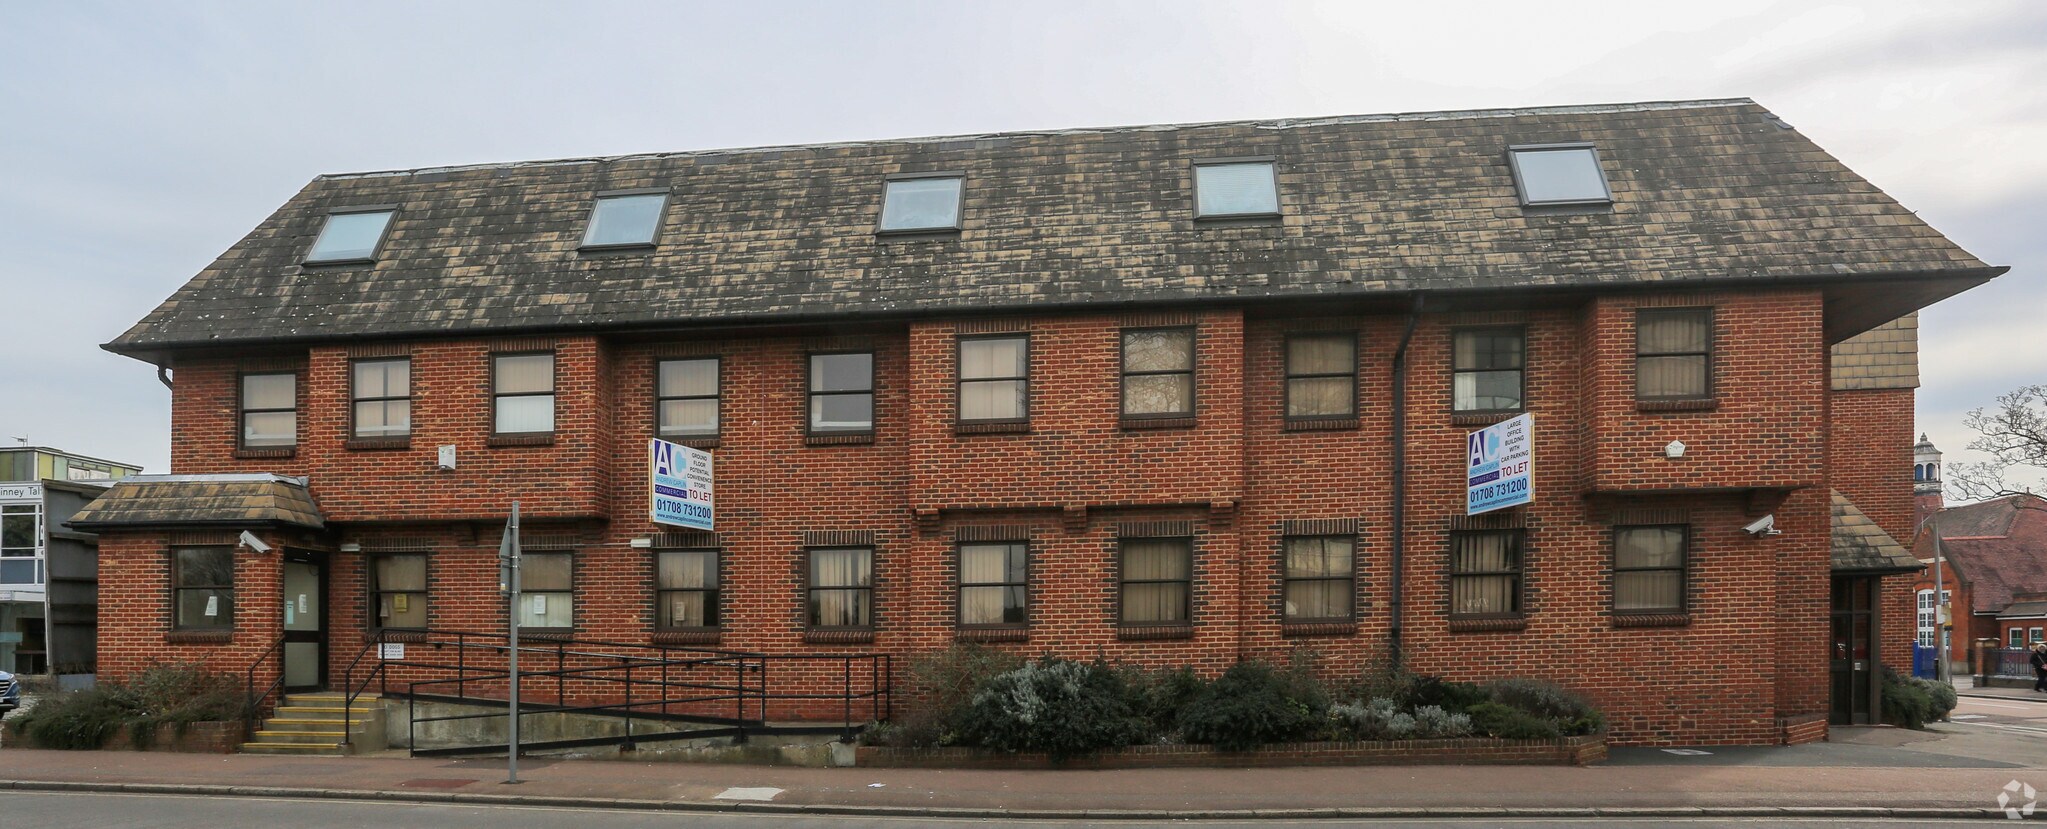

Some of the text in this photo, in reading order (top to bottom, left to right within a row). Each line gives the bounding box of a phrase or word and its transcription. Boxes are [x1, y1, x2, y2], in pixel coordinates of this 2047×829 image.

[1507, 420, 1522, 430] LARGE
[1506, 428, 1522, 438] OFFICE
[1504, 434, 1524, 446] BUILDING
[1469, 426, 1500, 468] AC
[1508, 444, 1520, 452] WITH
[655, 440, 686, 478] AC
[692, 452, 708, 462] GROUND
[1500, 450, 1529, 463] CAR PARKING
[690, 466, 710, 476] POTENTIAL
[1502, 461, 1528, 477] TO LET
[1469, 472, 1500, 486] COMMERCIAL
[28, 486, 42, 496] Tal
[656, 485, 687, 498] COMMERCIAL
[694, 482, 706, 490] STORE
[1470, 478, 1527, 502] 01708 731200
[688, 489, 712, 502] TO LET
[656, 498, 712, 518] 01708 731200
